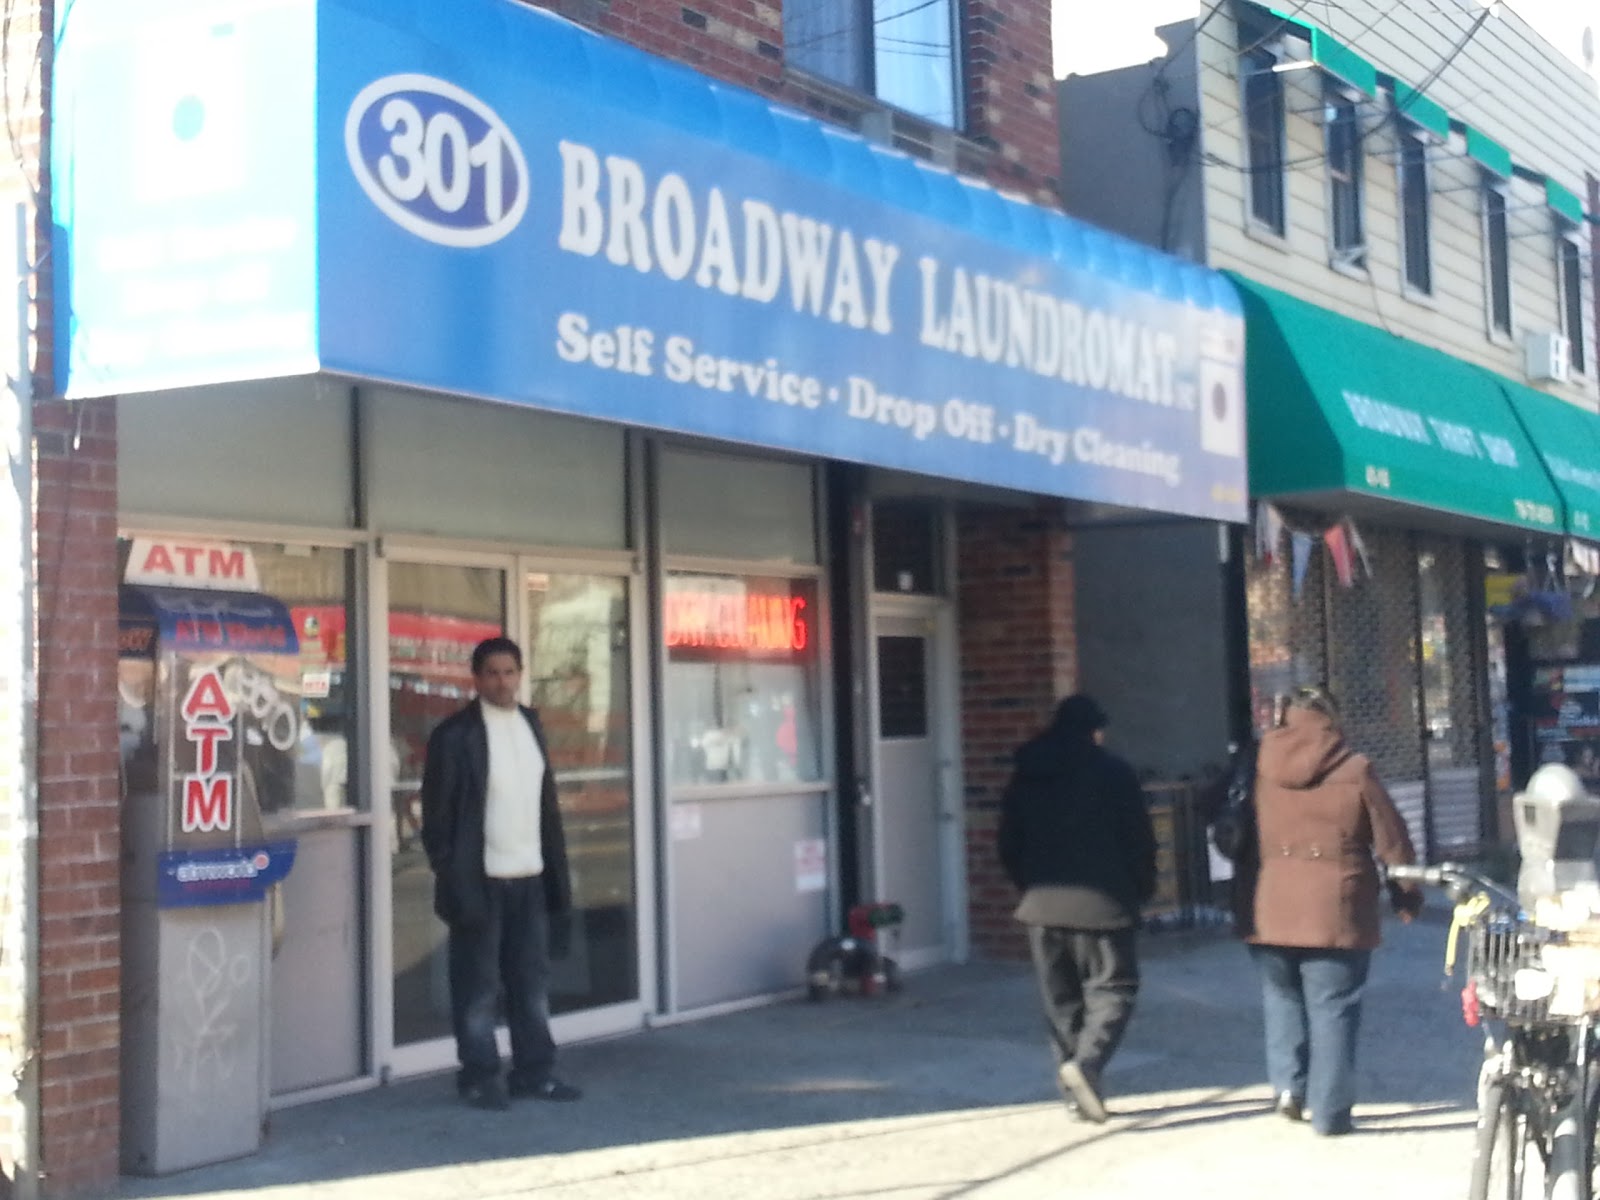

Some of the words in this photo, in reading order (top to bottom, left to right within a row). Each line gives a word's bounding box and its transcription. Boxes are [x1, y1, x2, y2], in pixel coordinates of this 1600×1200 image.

[377, 99, 501, 225] 301
[558, 138, 899, 336] BROADWAY
[919, 256, 1178, 405] LAUNDROMAT
[556, 313, 655, 379] Self
[663, 336, 821, 409] Service
[847, 377, 937, 441] Drop
[944, 398, 996, 446] Off
[1012, 413, 1067, 466] Dry
[1073, 424, 1181, 486] Cleaning
[142, 544, 246, 579] ATM
[183, 669, 234, 829] ATM
